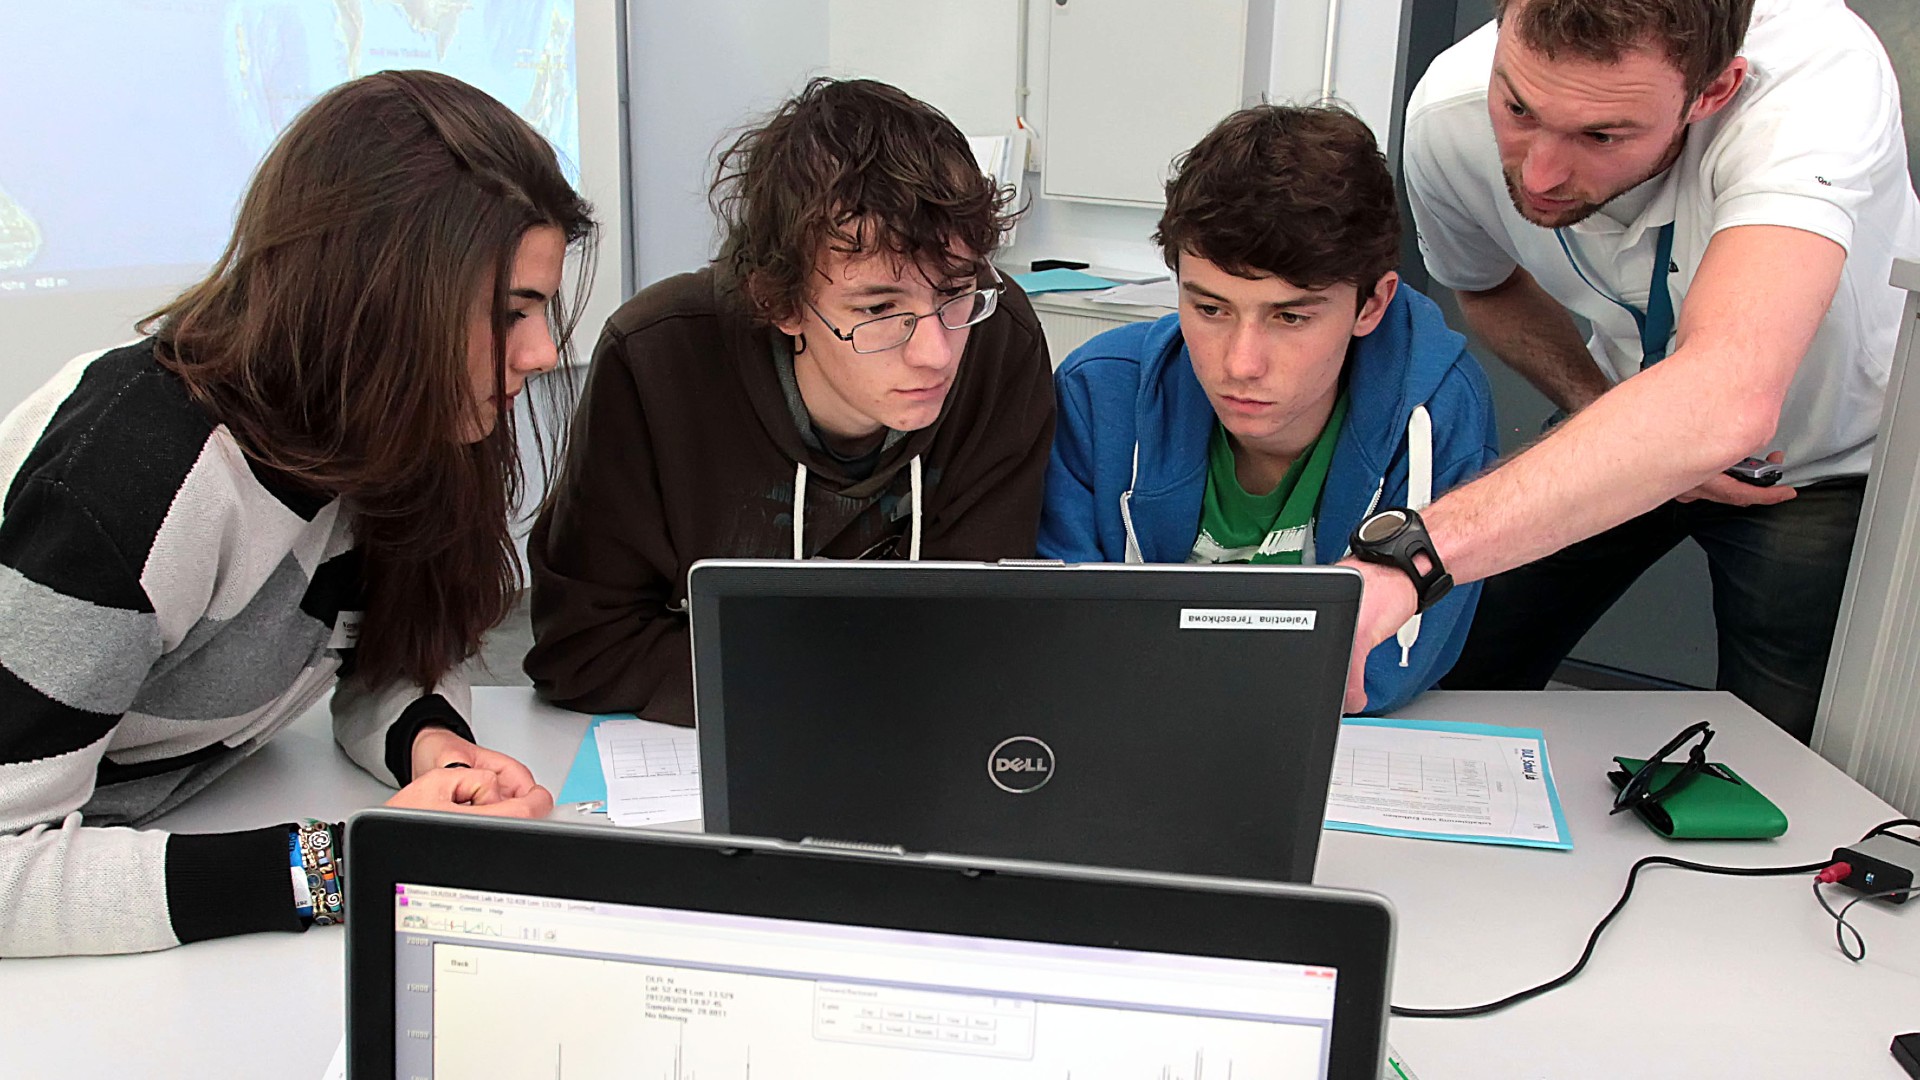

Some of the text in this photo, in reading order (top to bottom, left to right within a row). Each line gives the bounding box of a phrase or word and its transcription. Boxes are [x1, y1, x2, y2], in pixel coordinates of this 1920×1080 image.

[1187, 615, 1309, 625] Valentina Tereschkowa
[995, 757, 1048, 773] DELL
